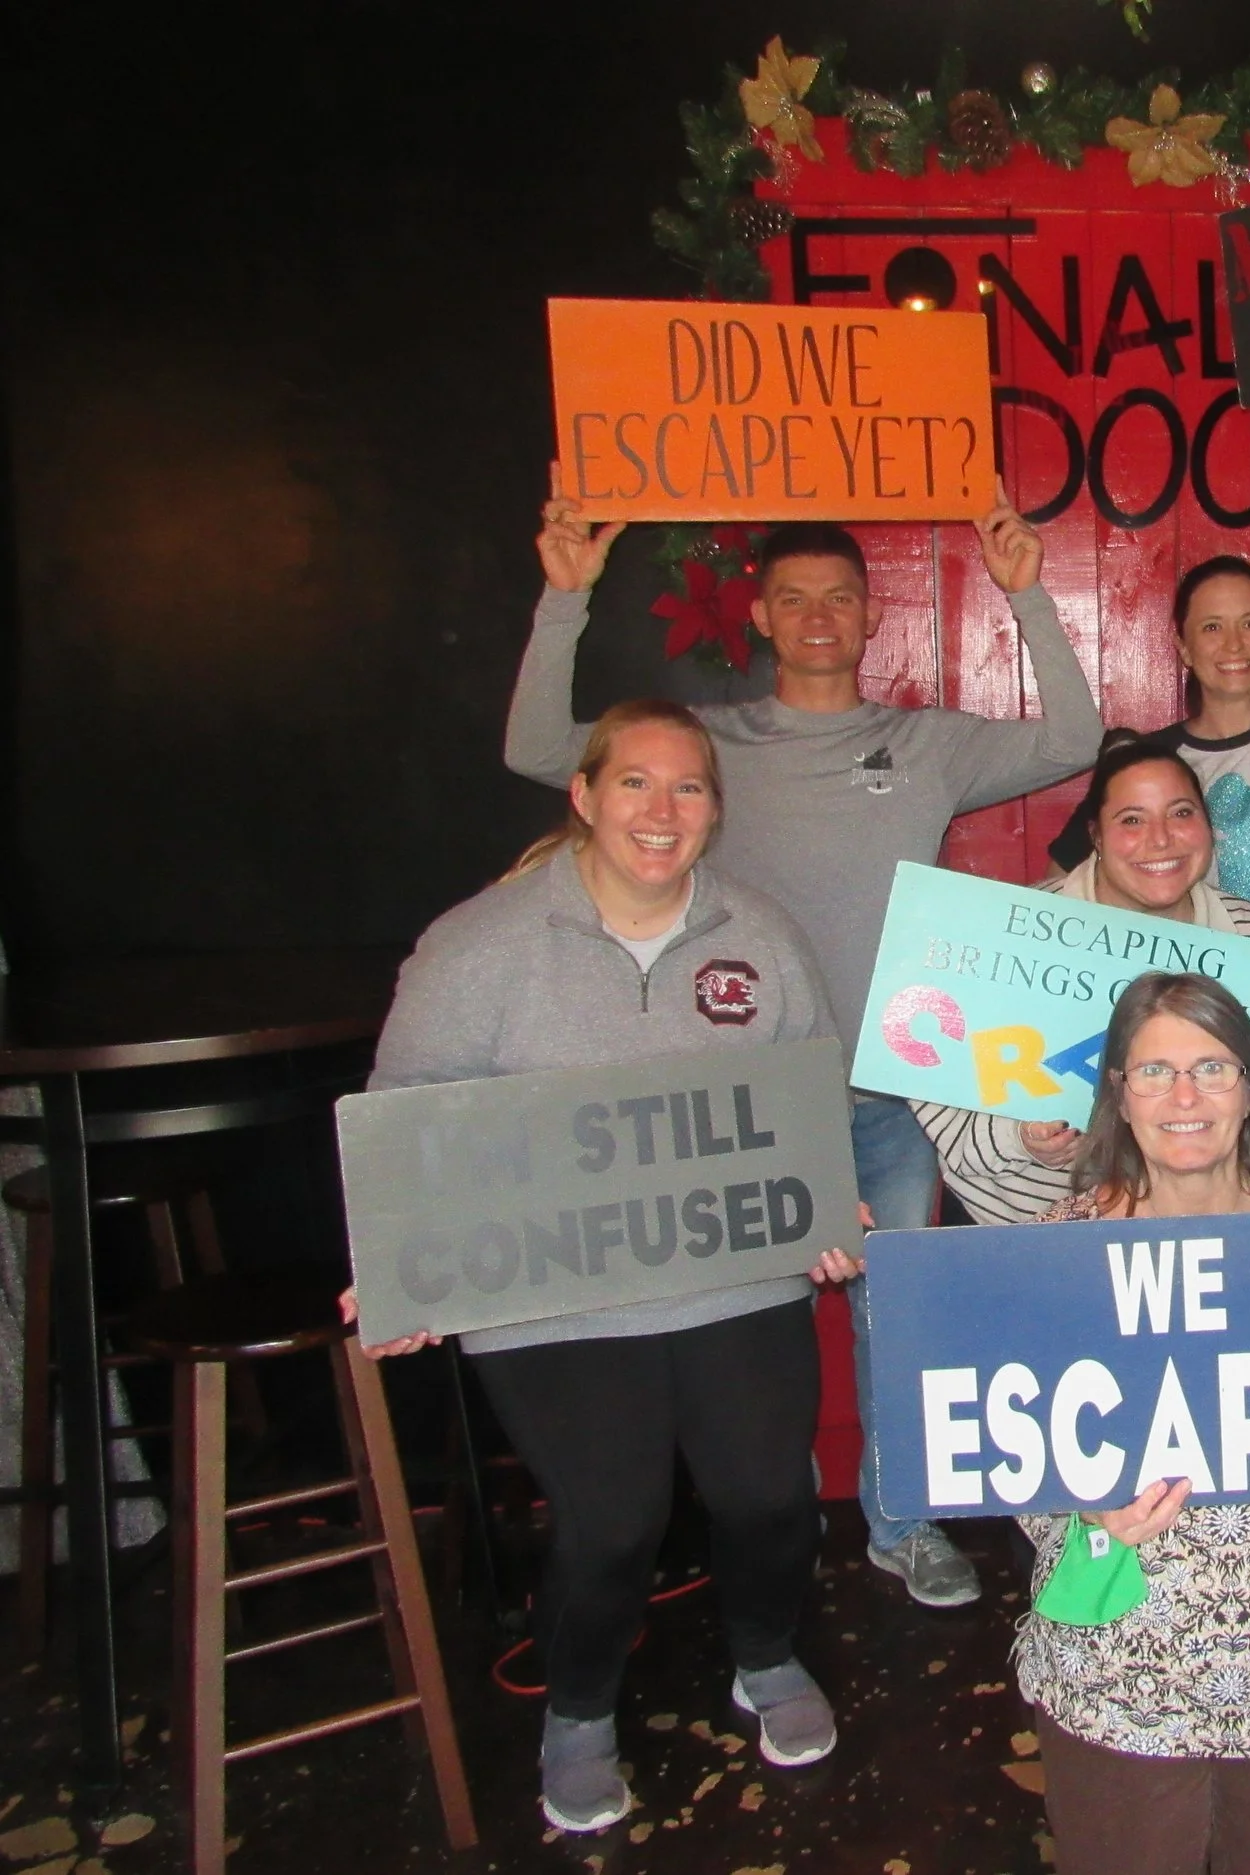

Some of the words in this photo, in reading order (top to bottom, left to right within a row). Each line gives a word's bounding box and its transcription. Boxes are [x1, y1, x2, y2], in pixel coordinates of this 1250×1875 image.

[667, 318, 762, 406] DID
[777, 322, 882, 408] WE
[573, 412, 818, 500] ESCAPE
[832, 415, 977, 498] YET?
[922, 935, 1097, 1002] BRINGS
[1002, 903, 1227, 981] ESCAPING
[572, 1083, 776, 1174] STILL
[398, 1175, 814, 1305] CONFUSED
[1106, 1238, 1228, 1337] WE
